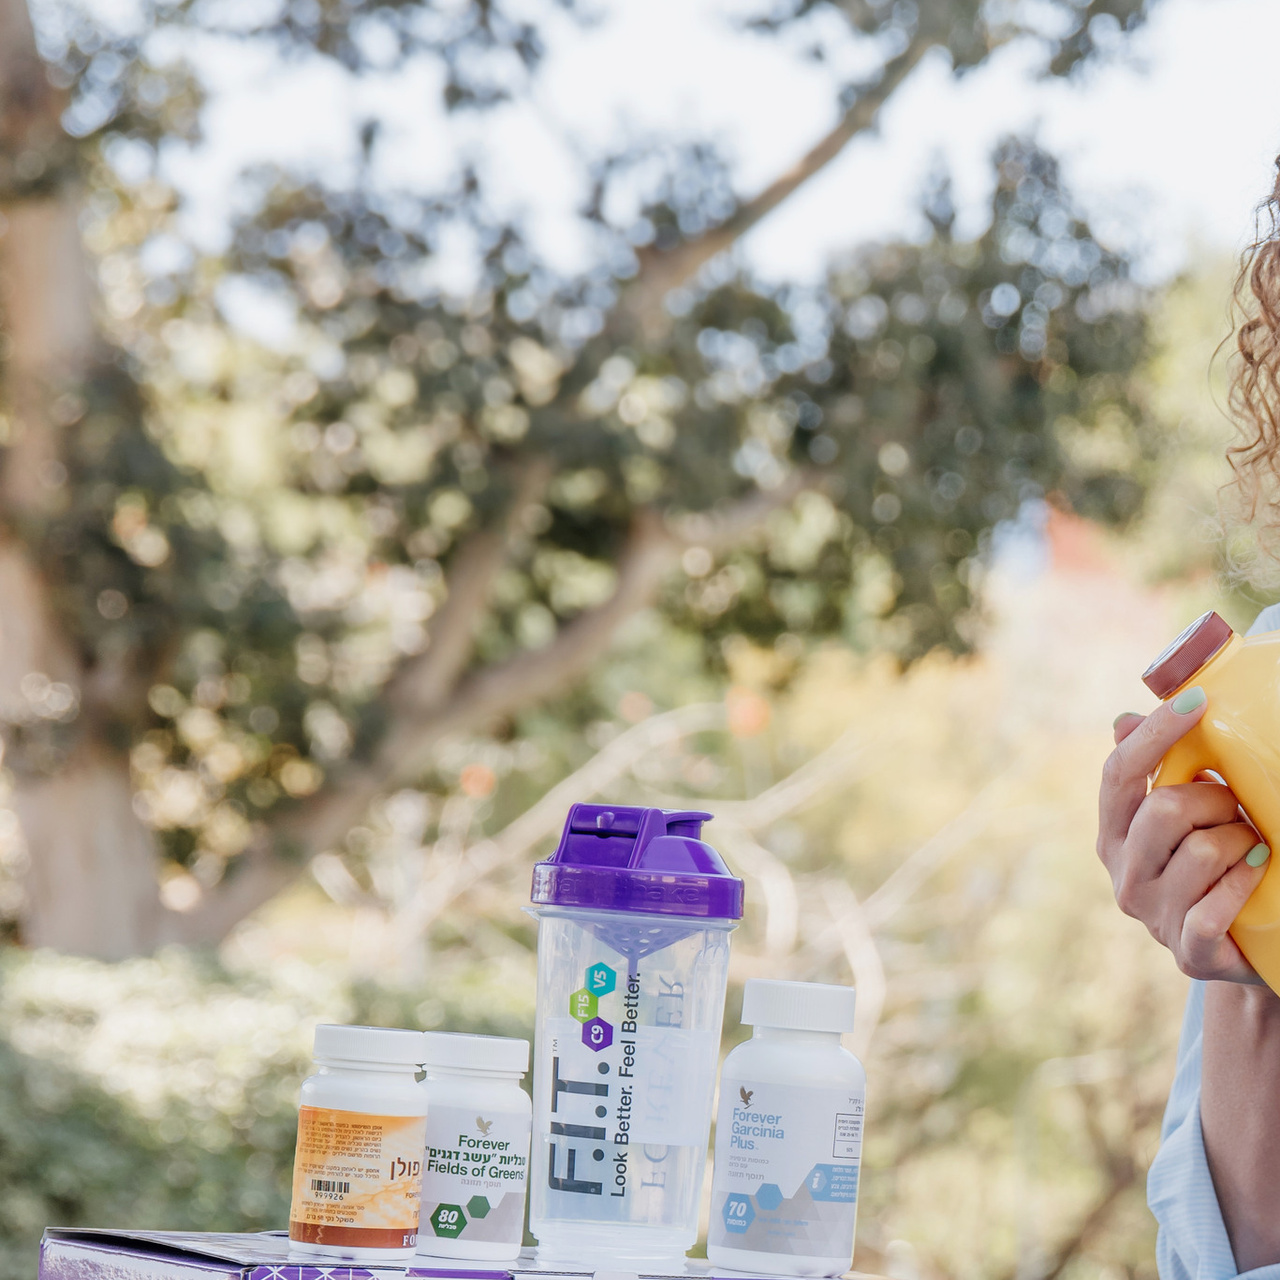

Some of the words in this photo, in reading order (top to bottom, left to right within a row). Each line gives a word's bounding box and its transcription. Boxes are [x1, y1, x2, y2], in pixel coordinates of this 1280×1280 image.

[594, 970, 606, 988] V5
[578, 994, 589, 1018] F15
[621, 973, 641, 1033] Better.
[591, 1025, 604, 1044] C9
[618, 1040, 636, 1077] Feel
[614, 1085, 633, 1145] Better.
[733, 1108, 782, 1125] Forever
[548, 1056, 610, 1195] F.I.T.
[732, 1122, 784, 1139] Garcinia
[459, 1135, 510, 1150] Forever
[730, 1135, 754, 1150] Plus
[390, 1157, 420, 1180] פולן
[428, 1159, 467, 1175] Fields
[472, 1165, 485, 1177] of
[489, 1166, 524, 1180] Greens
[611, 1152, 628, 1197] Look
[315, 1191, 344, 1200] 999926
[438, 1210, 458, 1223] 80
[729, 1201, 747, 1217] 70
[402, 1234, 417, 1247] FO
